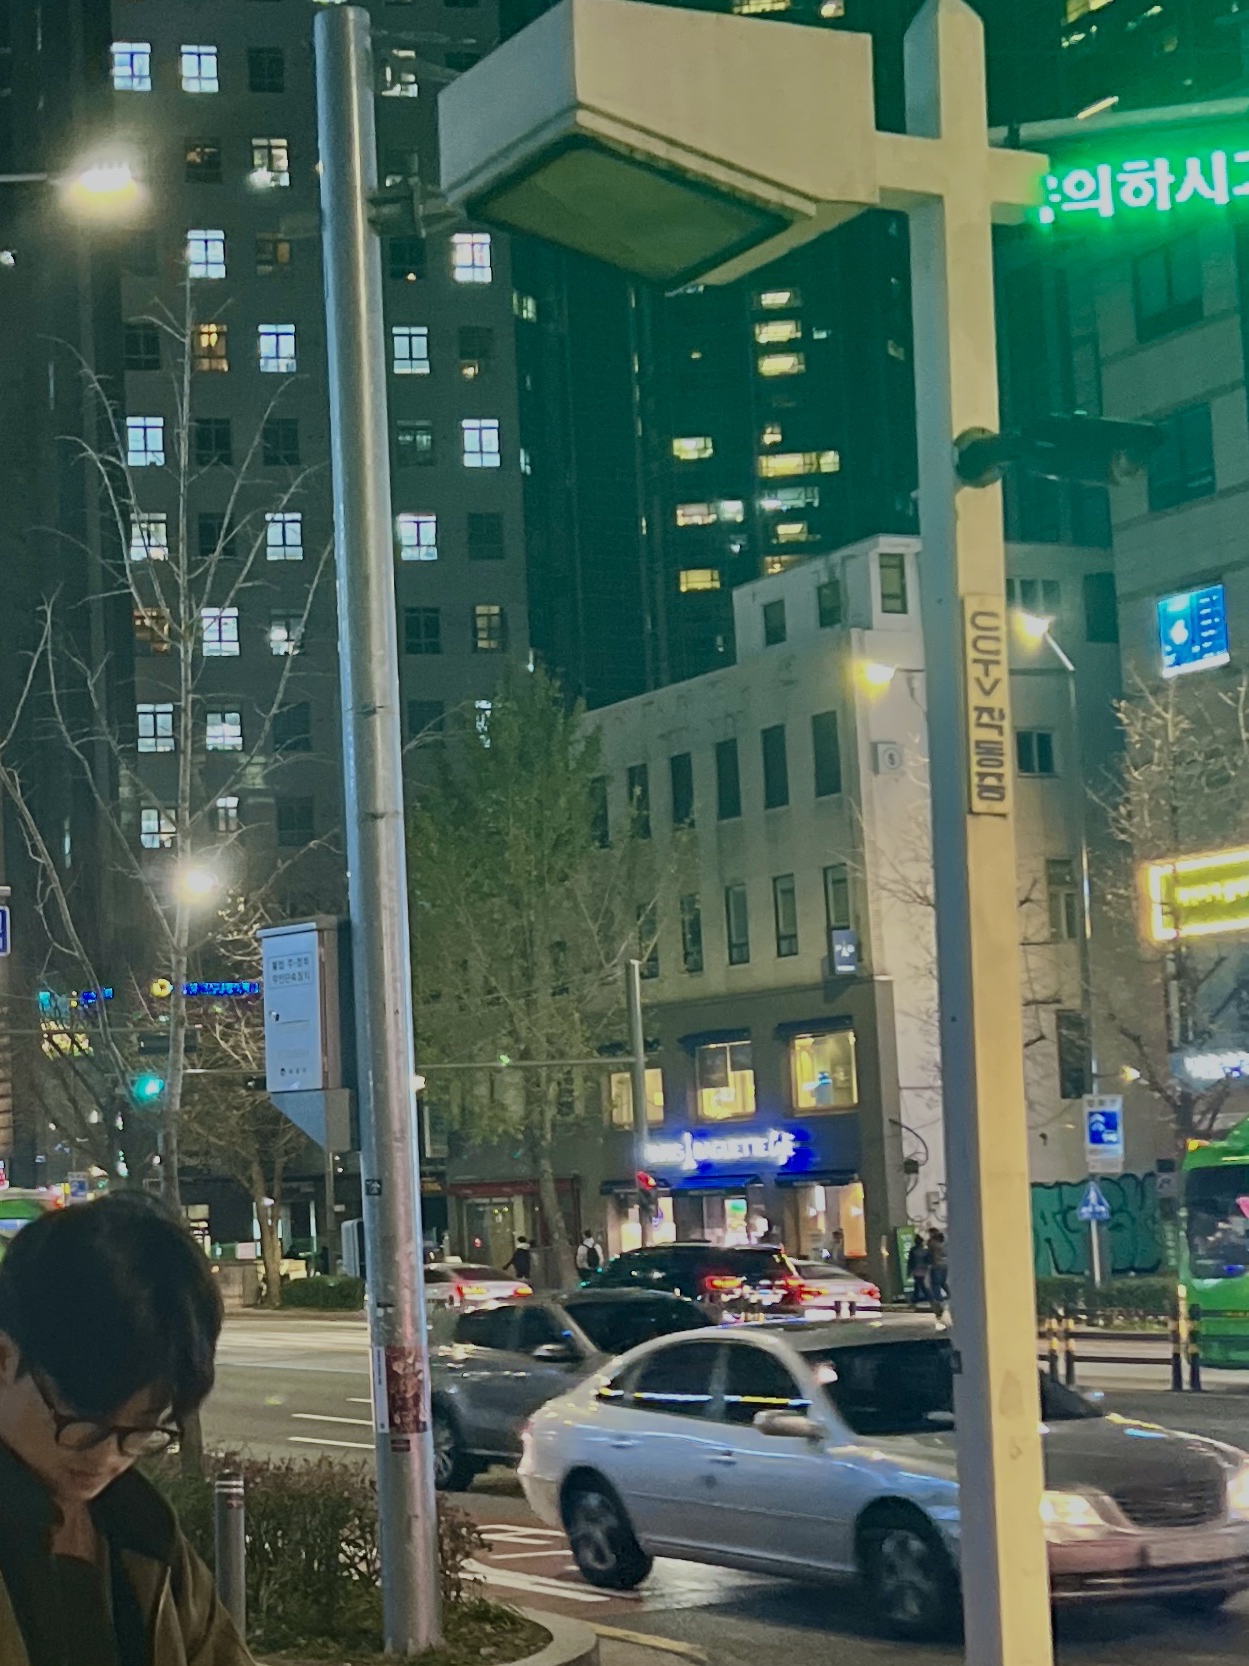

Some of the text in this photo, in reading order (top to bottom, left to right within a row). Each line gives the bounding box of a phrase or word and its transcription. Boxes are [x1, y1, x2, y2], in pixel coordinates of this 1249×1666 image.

[1039, 150, 1249, 224] 의하시
[970, 611, 1002, 697] CCTV
[973, 706, 1006, 802] 작동중
